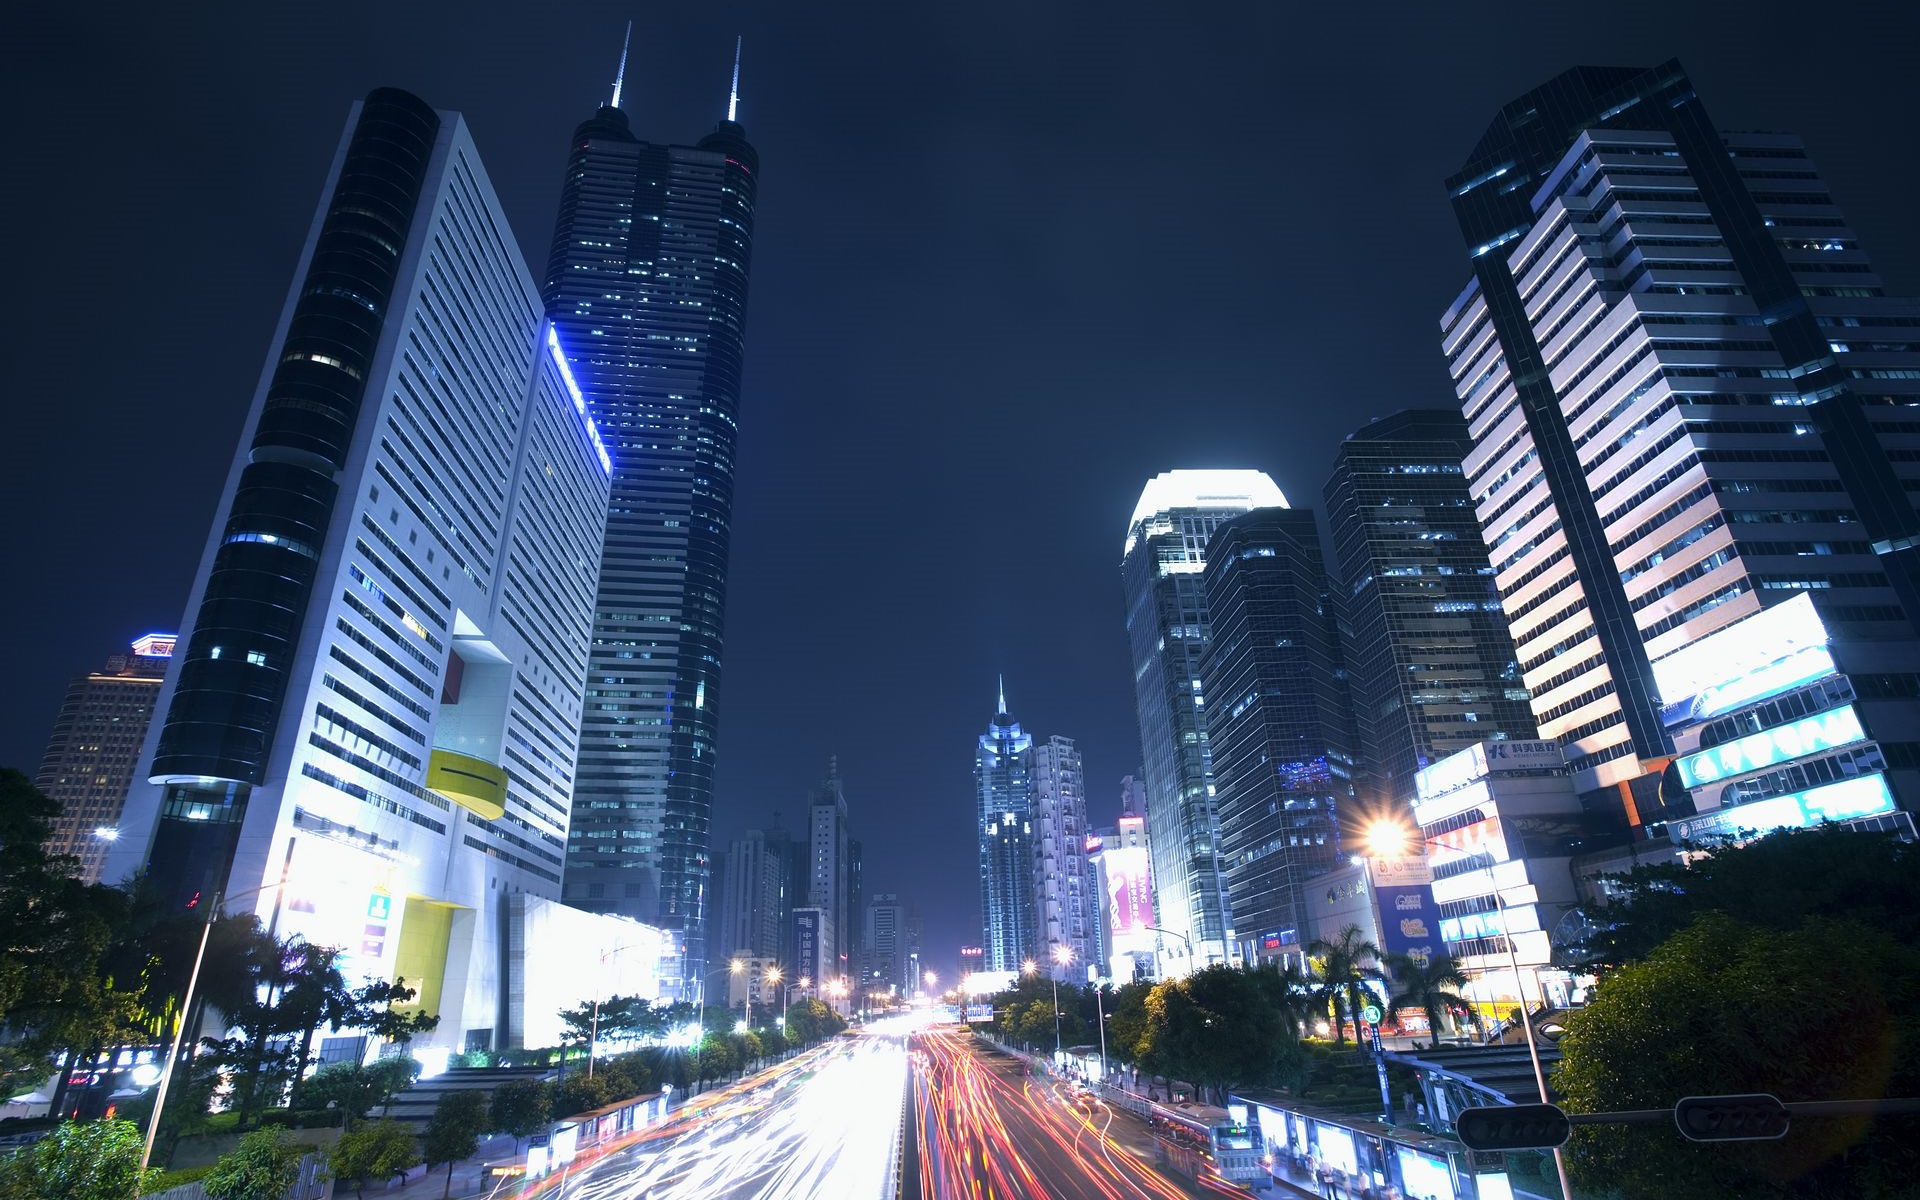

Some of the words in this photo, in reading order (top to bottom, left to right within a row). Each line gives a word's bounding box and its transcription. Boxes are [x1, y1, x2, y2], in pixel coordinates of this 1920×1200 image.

[1511, 743, 1555, 753] 科美医疗
[802, 932, 812, 982] 中国南方电
